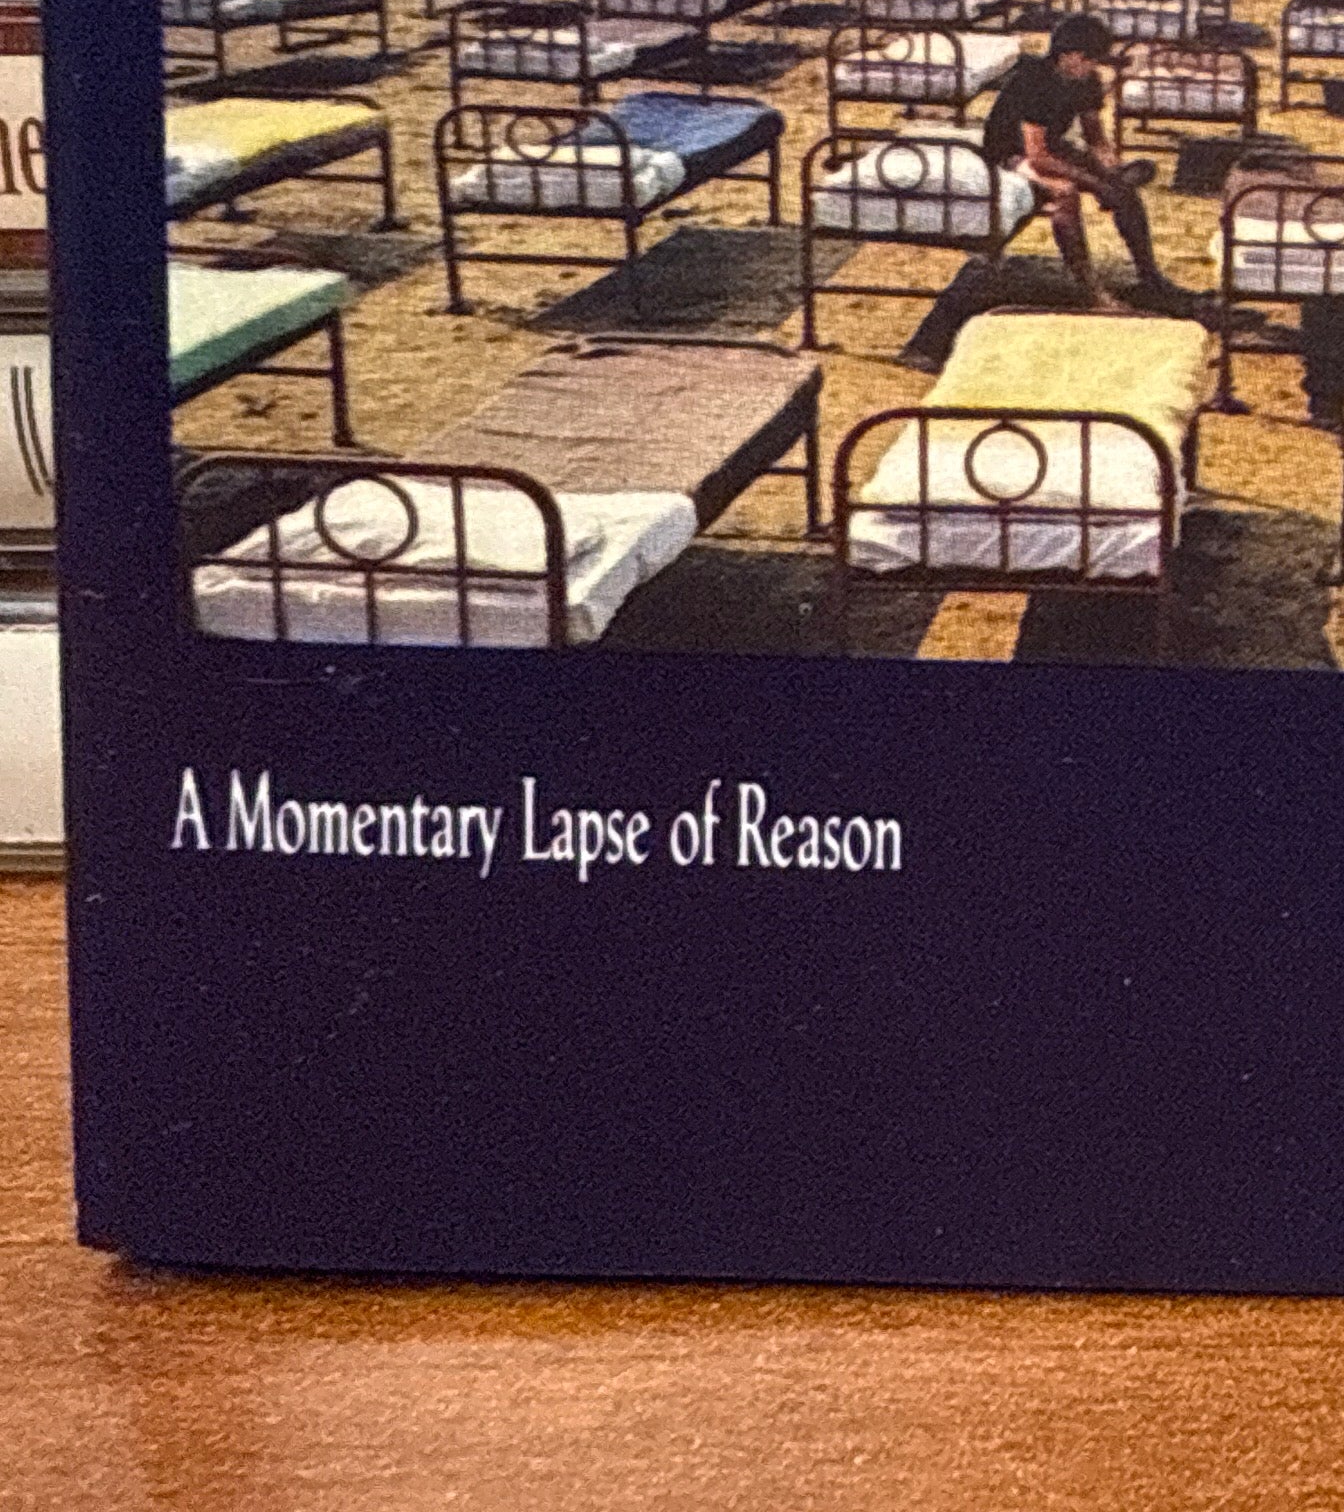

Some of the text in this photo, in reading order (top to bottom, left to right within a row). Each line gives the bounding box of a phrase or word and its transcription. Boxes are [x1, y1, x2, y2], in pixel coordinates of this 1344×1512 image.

[171, 767, 902, 883] A Momentary Lapse of Reason
